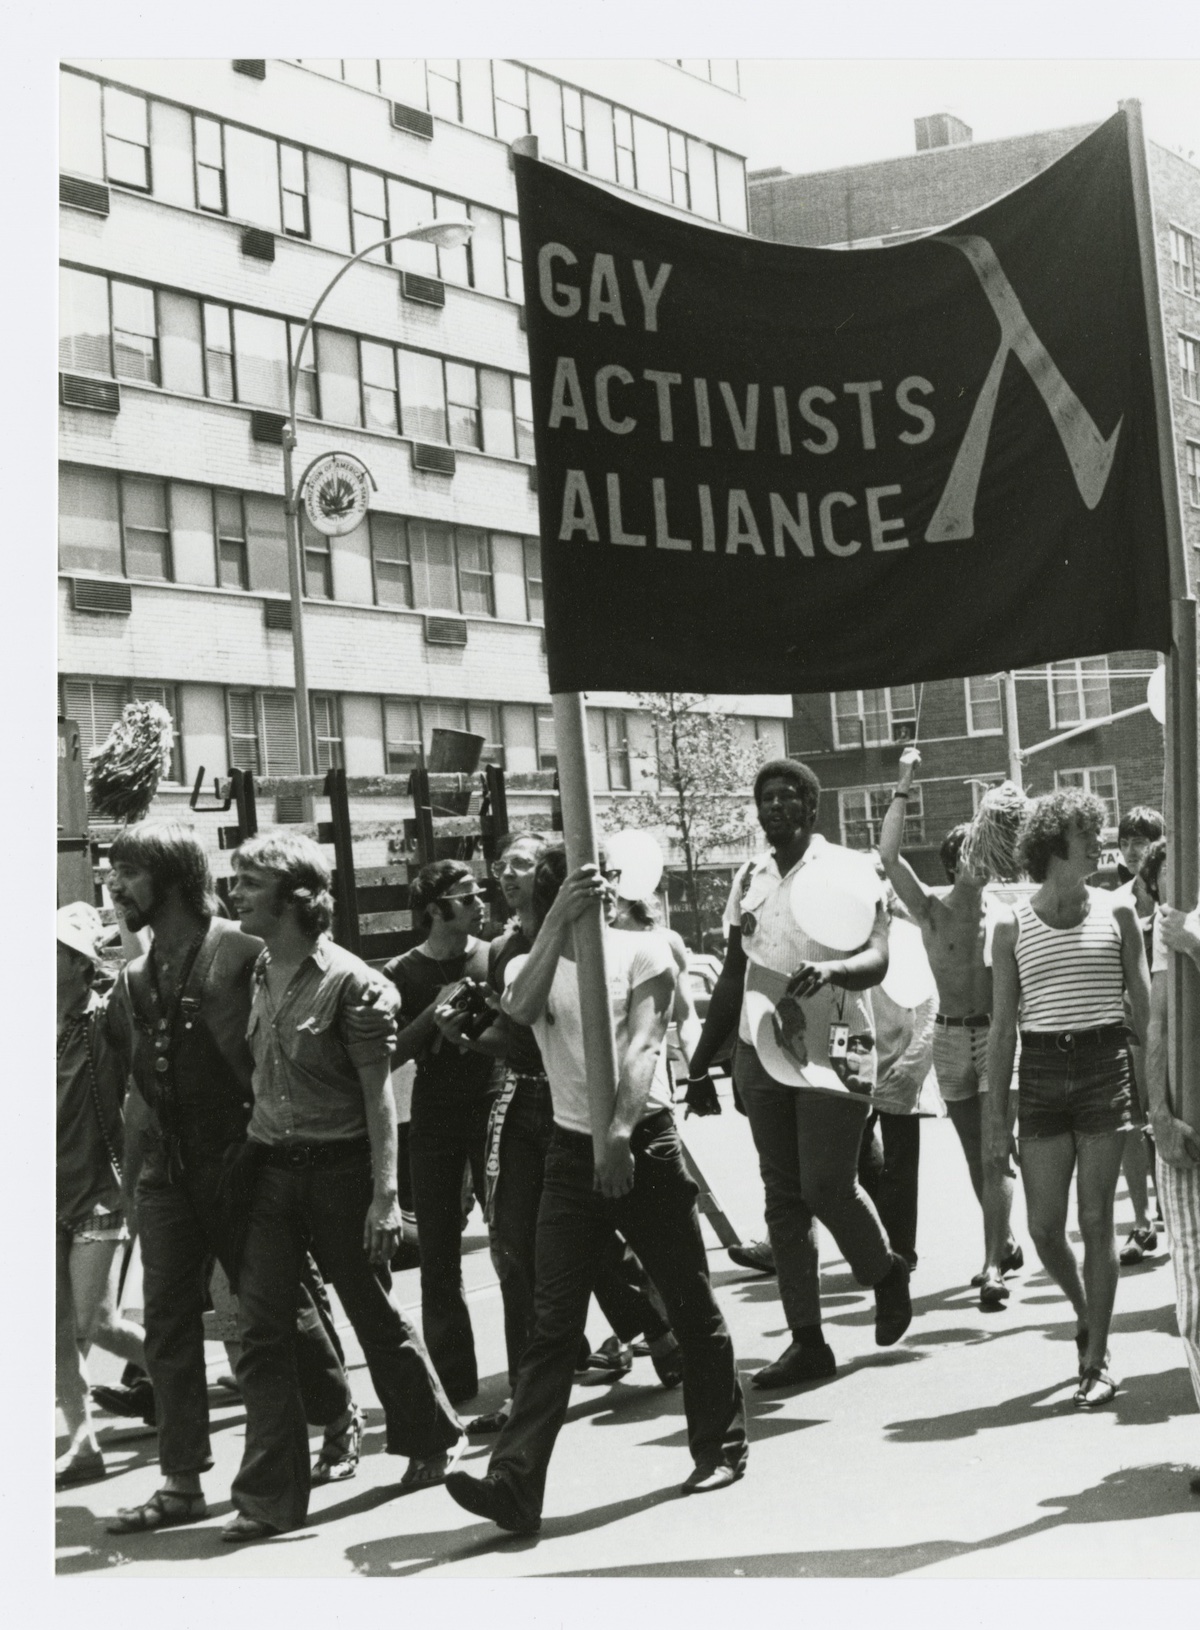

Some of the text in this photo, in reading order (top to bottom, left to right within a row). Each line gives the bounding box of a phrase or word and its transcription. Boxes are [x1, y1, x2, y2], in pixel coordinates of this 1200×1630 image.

[537, 242, 672, 332] GAY
[548, 356, 936, 456] ACTIVISTS
[558, 470, 909, 558] ALLIANCE
